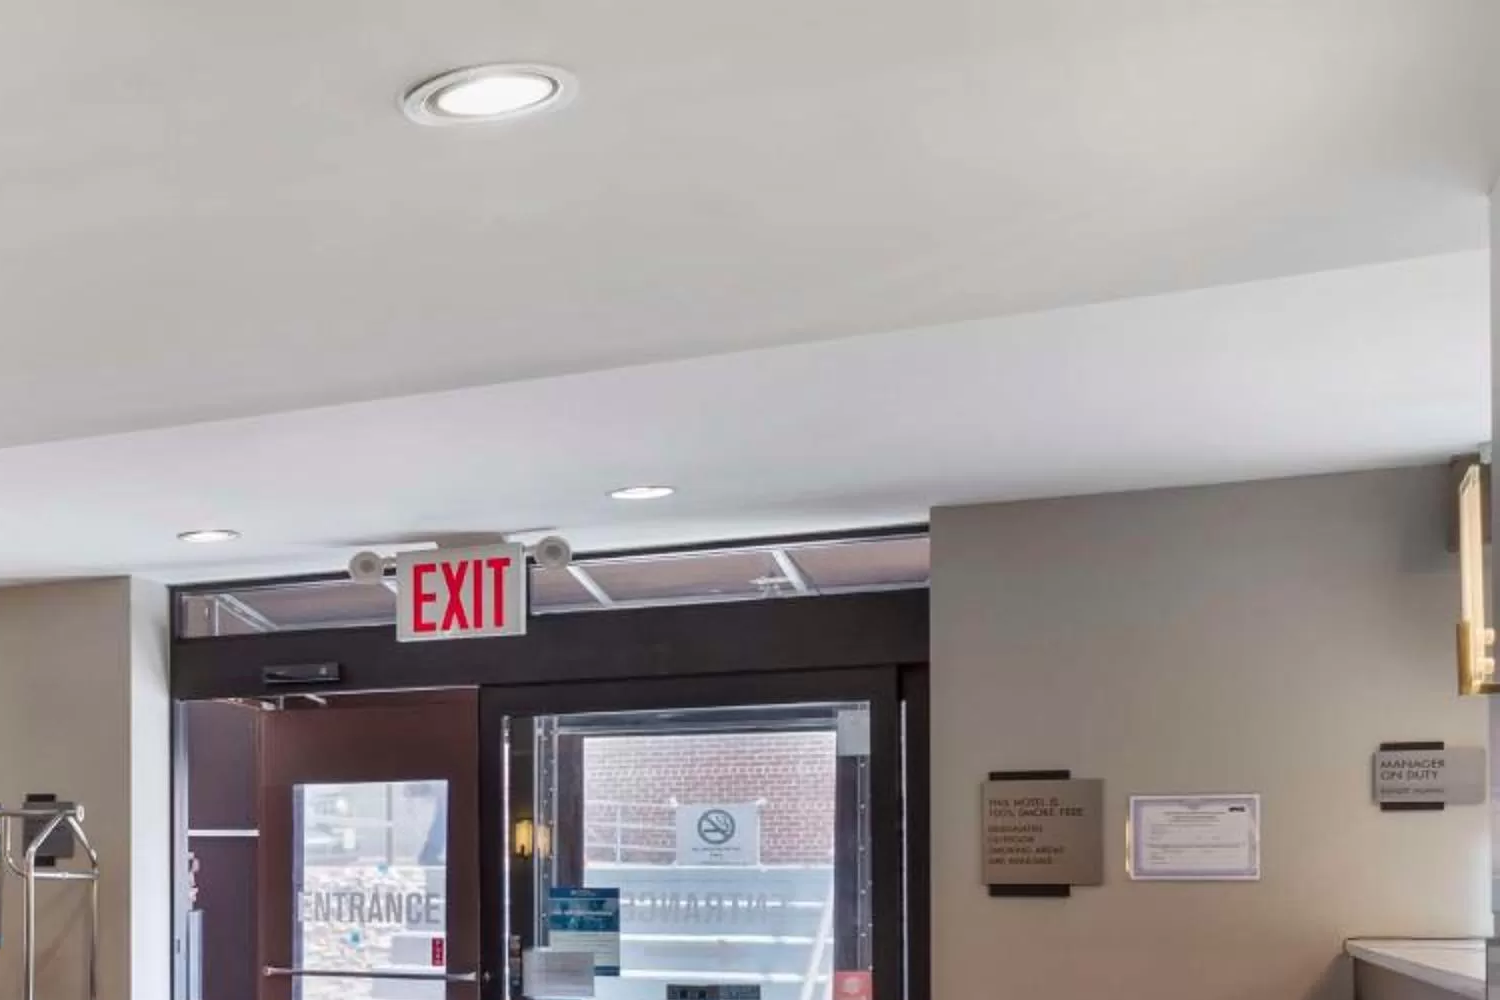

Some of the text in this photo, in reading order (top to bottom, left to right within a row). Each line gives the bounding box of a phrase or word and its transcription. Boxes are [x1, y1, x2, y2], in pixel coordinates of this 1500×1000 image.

[413, 557, 511, 632] EXIT
[1380, 759, 1444, 768] MANAGER
[1381, 770, 1438, 780] ON DUTY
[298, 890, 441, 924] ENTRANCE
